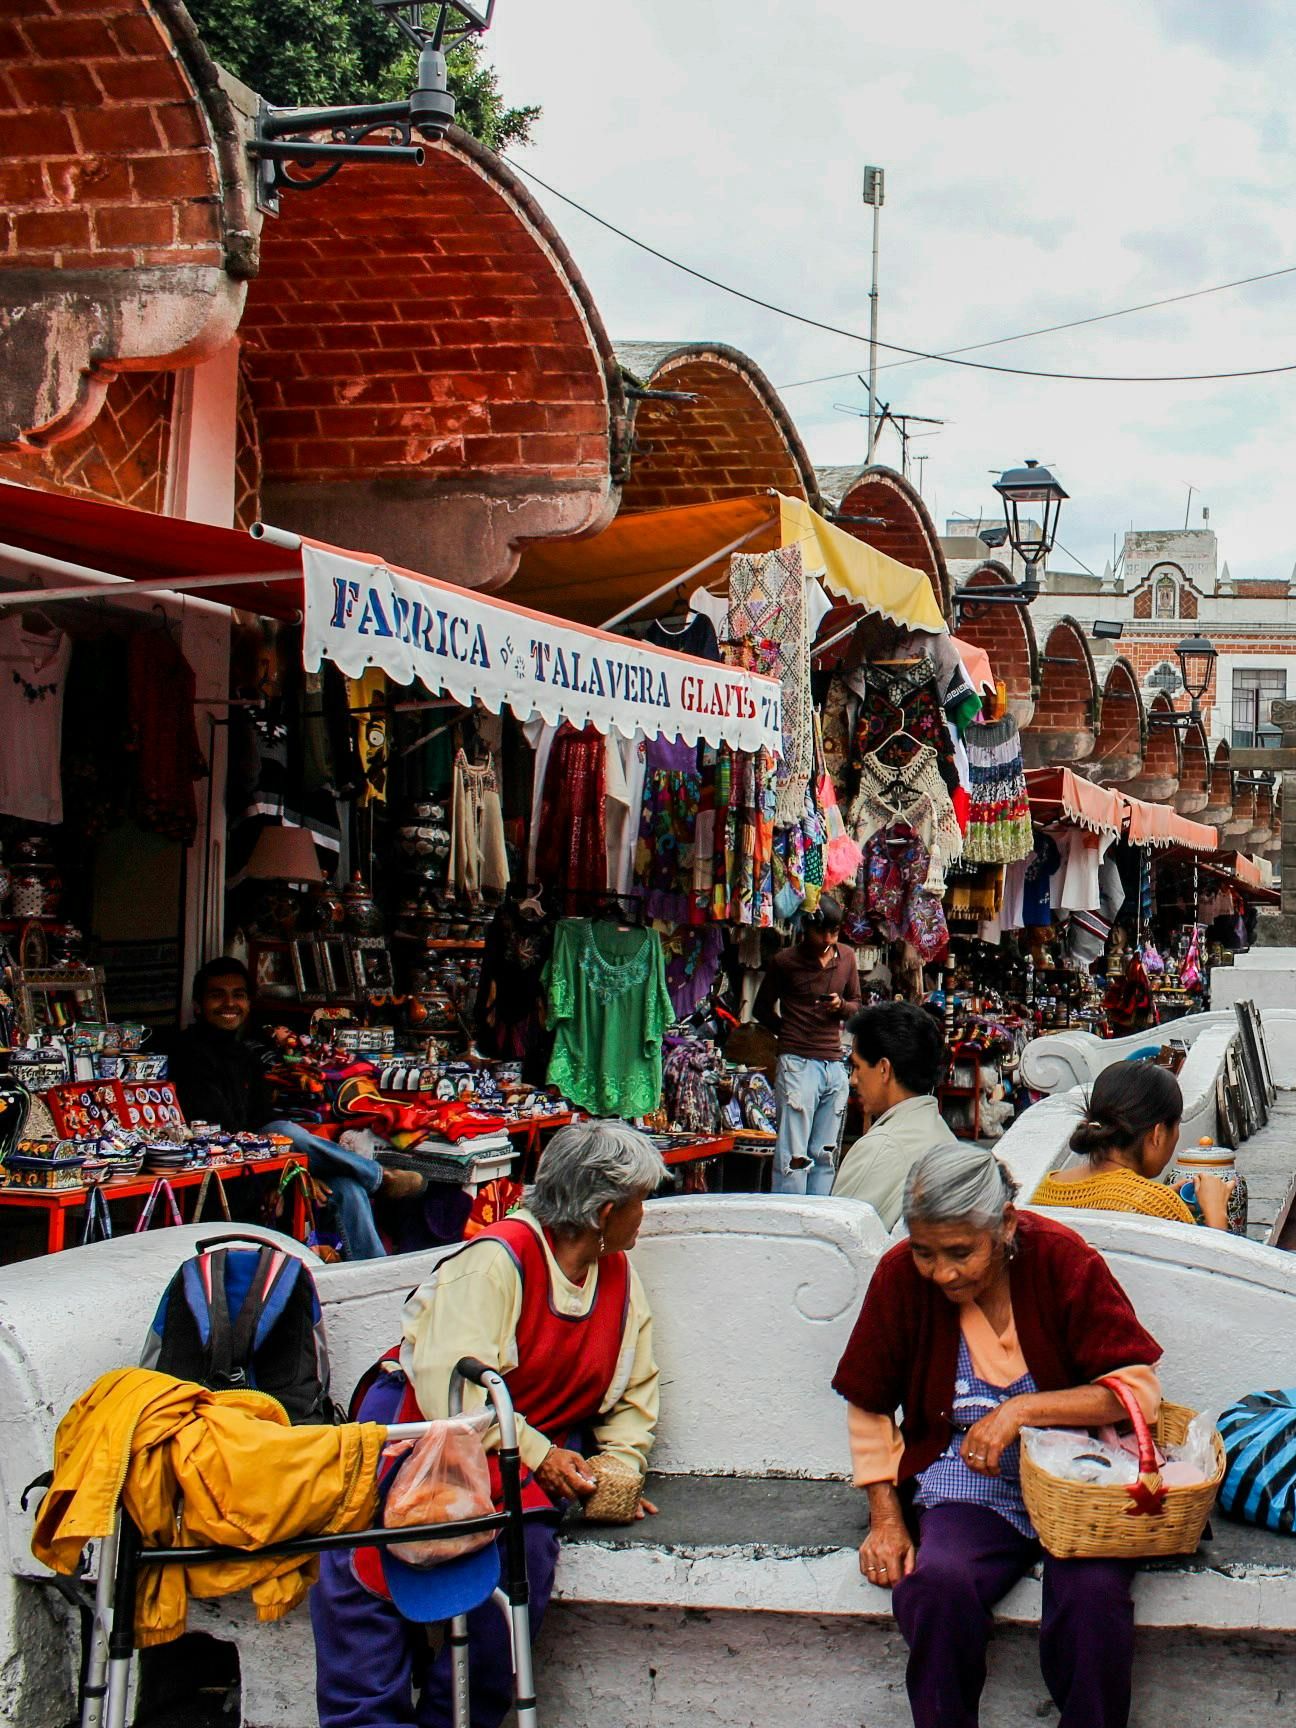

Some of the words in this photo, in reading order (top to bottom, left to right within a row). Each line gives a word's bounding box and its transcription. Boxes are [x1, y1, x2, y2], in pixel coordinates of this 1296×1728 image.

[330, 577, 491, 669] FABRICA
[500, 635, 514, 665] DE
[530, 639, 671, 708] TALAVERA
[762, 696, 780, 731] 71
